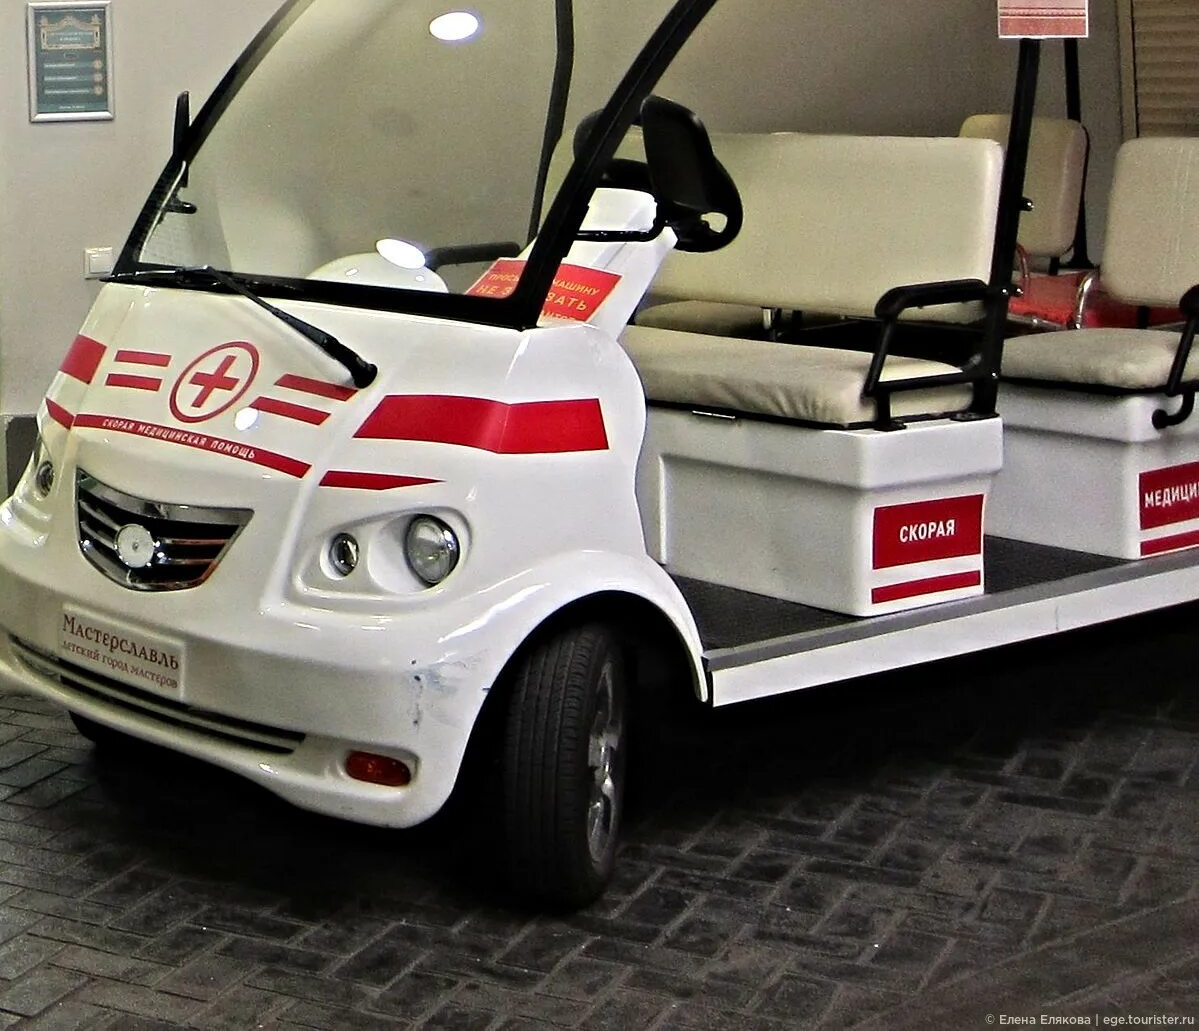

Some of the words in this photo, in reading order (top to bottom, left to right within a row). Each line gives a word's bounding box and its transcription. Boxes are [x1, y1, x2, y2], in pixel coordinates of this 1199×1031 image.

[102, 418, 135, 431] СКОРАЯ
[137, 423, 207, 448] МЕДИЦИНСКАЯ
[211, 440, 255, 459] ПОМОЩЬ
[1144, 481, 1199, 508] МЕДИЦИ
[900, 519, 955, 543] СКОРАЯ
[102, 654, 129, 674] город
